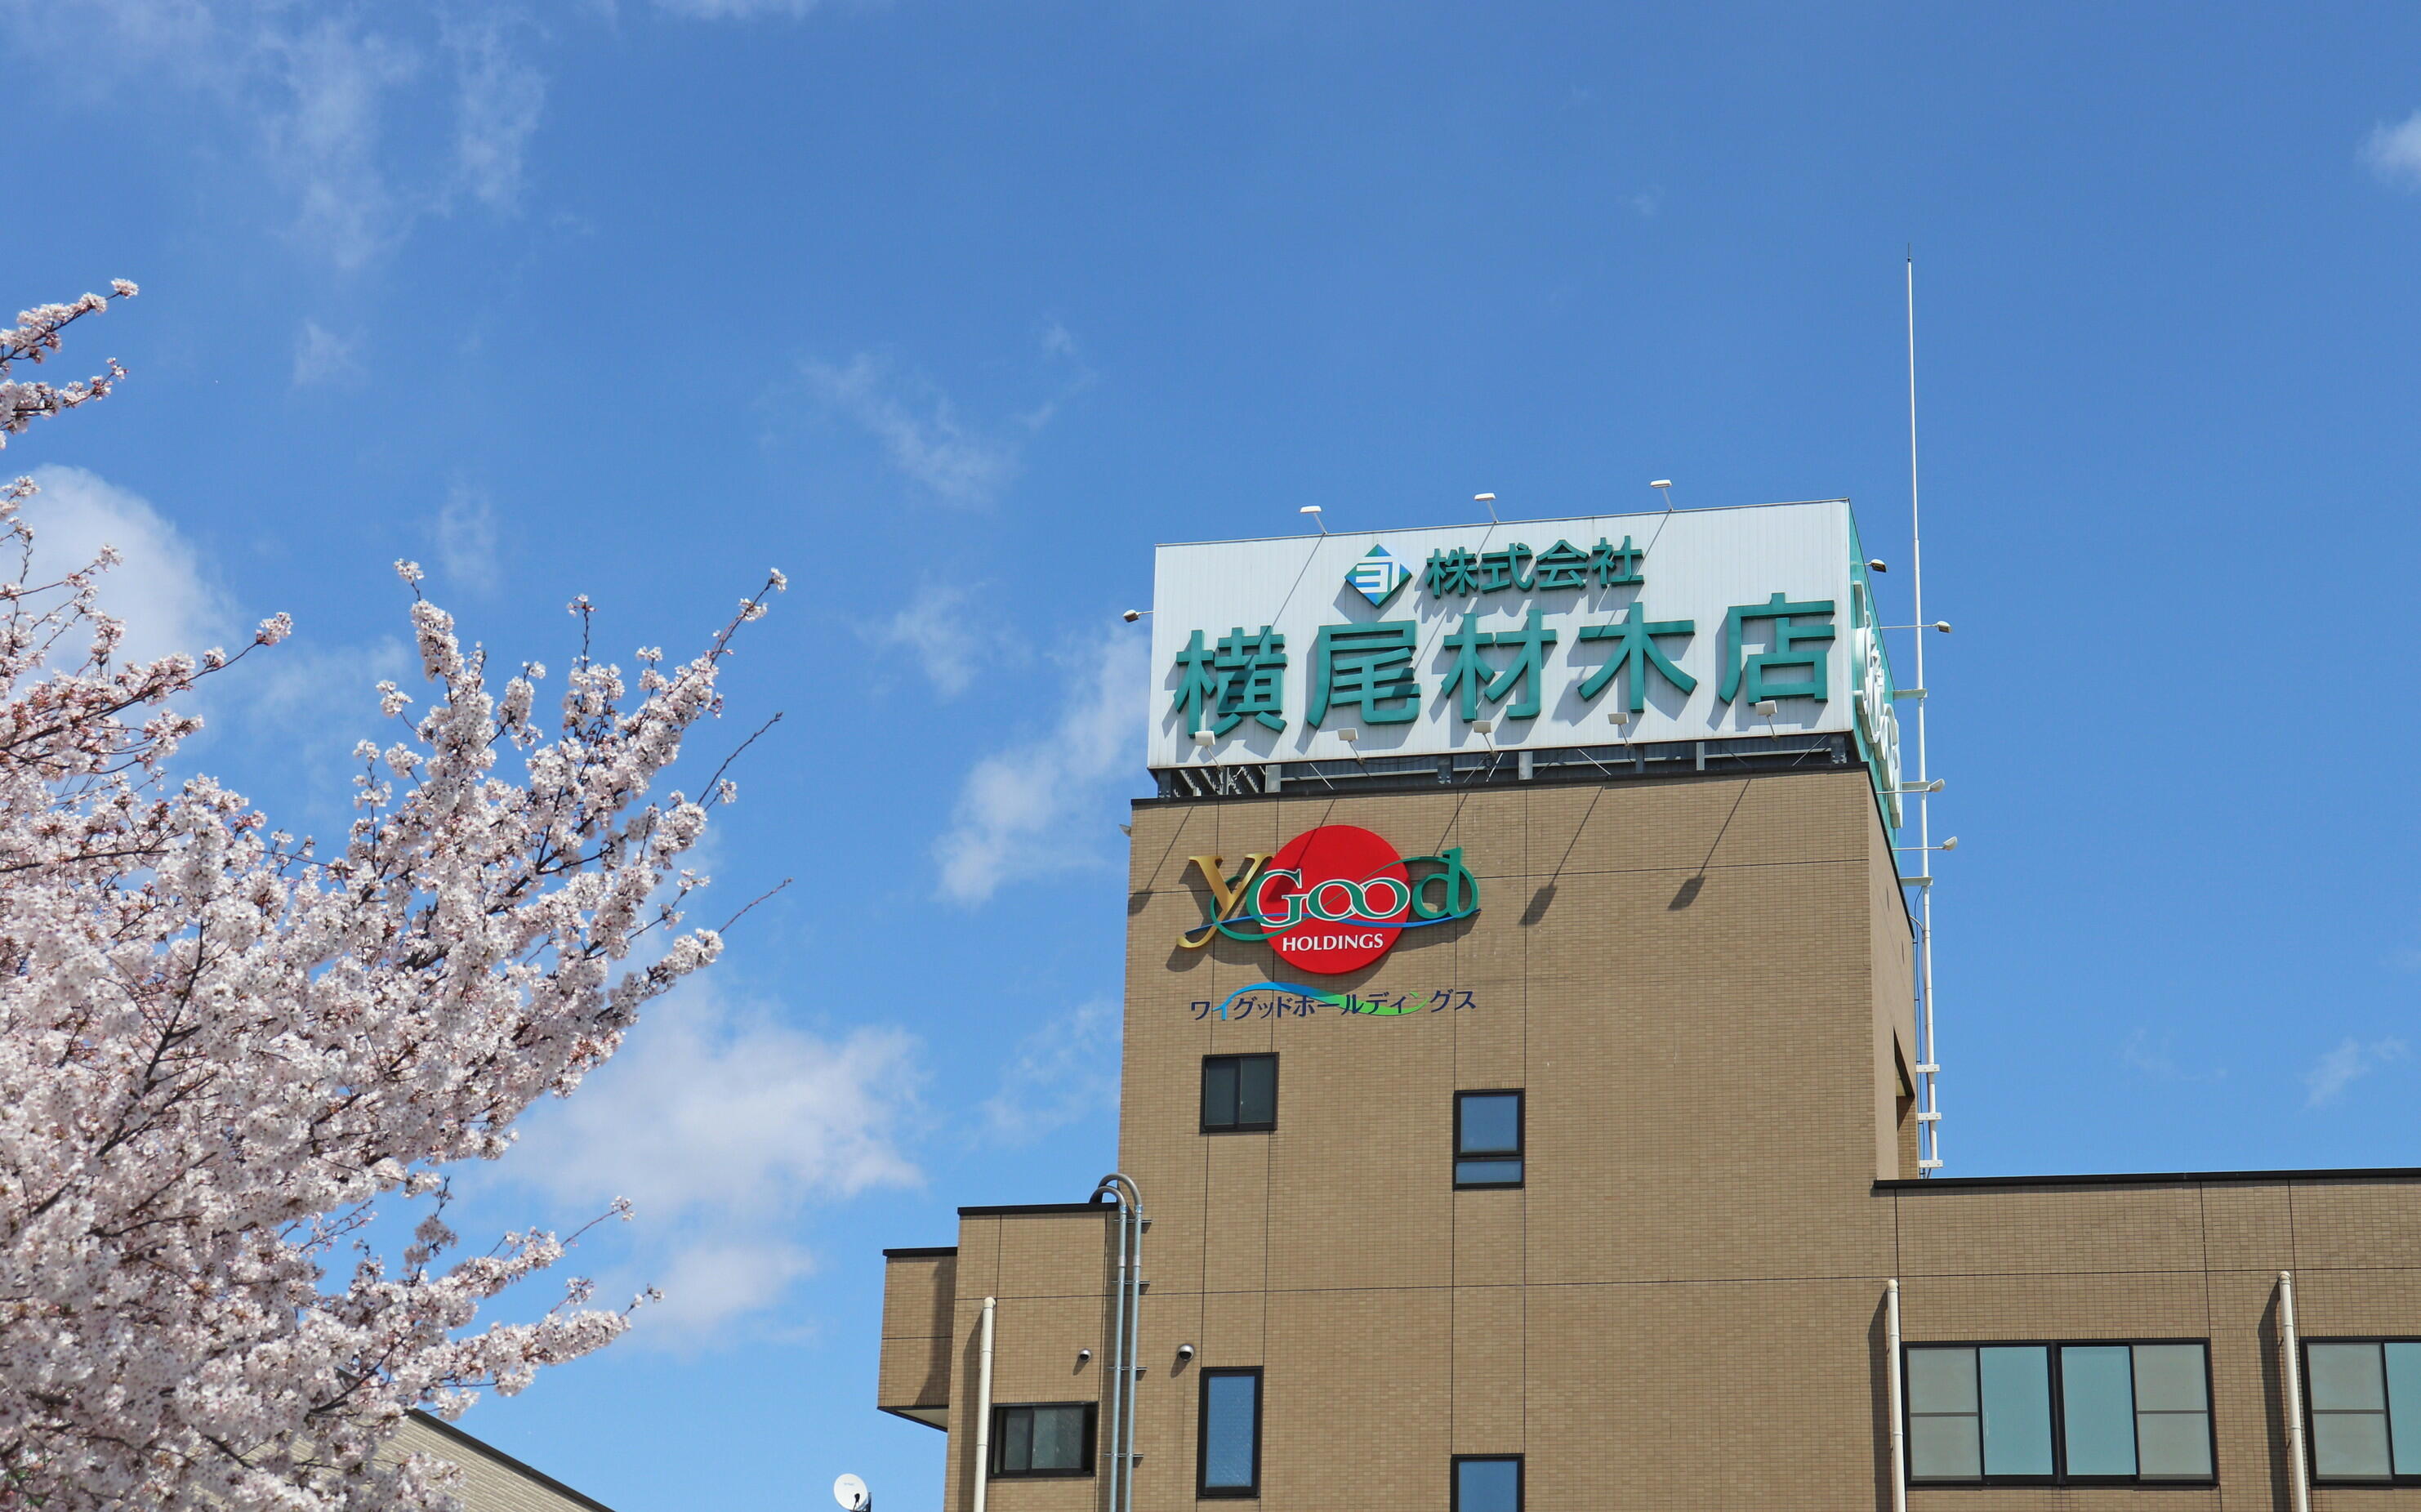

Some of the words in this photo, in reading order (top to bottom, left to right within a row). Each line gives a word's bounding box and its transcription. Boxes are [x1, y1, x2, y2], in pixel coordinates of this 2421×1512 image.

[1425, 535, 1645, 599] 株式会社
[1173, 592, 1836, 738] 横尾材木店
[1282, 933, 1384, 952] HOLDINGS
[1190, 988, 1477, 1020] ワイグッドホールディングス
